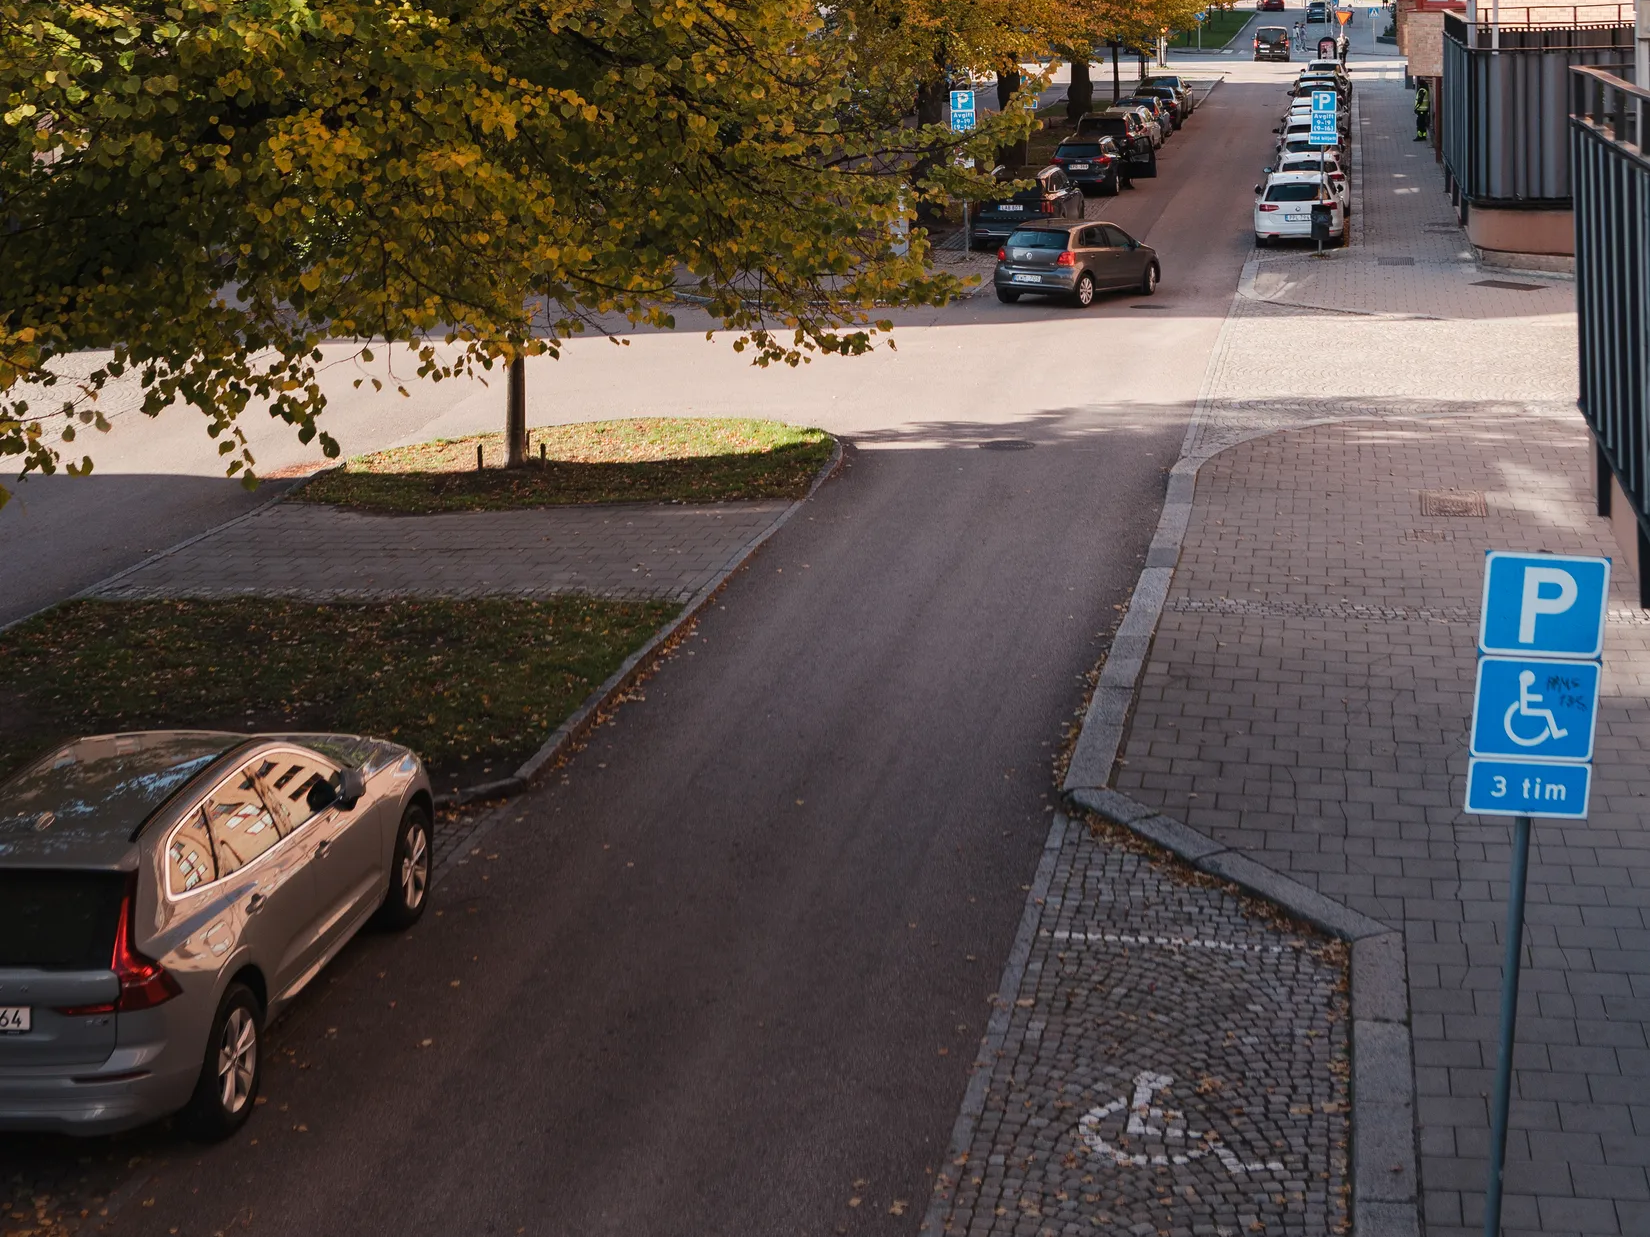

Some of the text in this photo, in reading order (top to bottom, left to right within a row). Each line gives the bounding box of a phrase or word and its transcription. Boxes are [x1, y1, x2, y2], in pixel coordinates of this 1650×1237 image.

[957, 93, 969, 109] P
[1319, 93, 1331, 110] P
[1518, 566, 1578, 644] P
[1490, 775, 1567, 801] 3 tim
